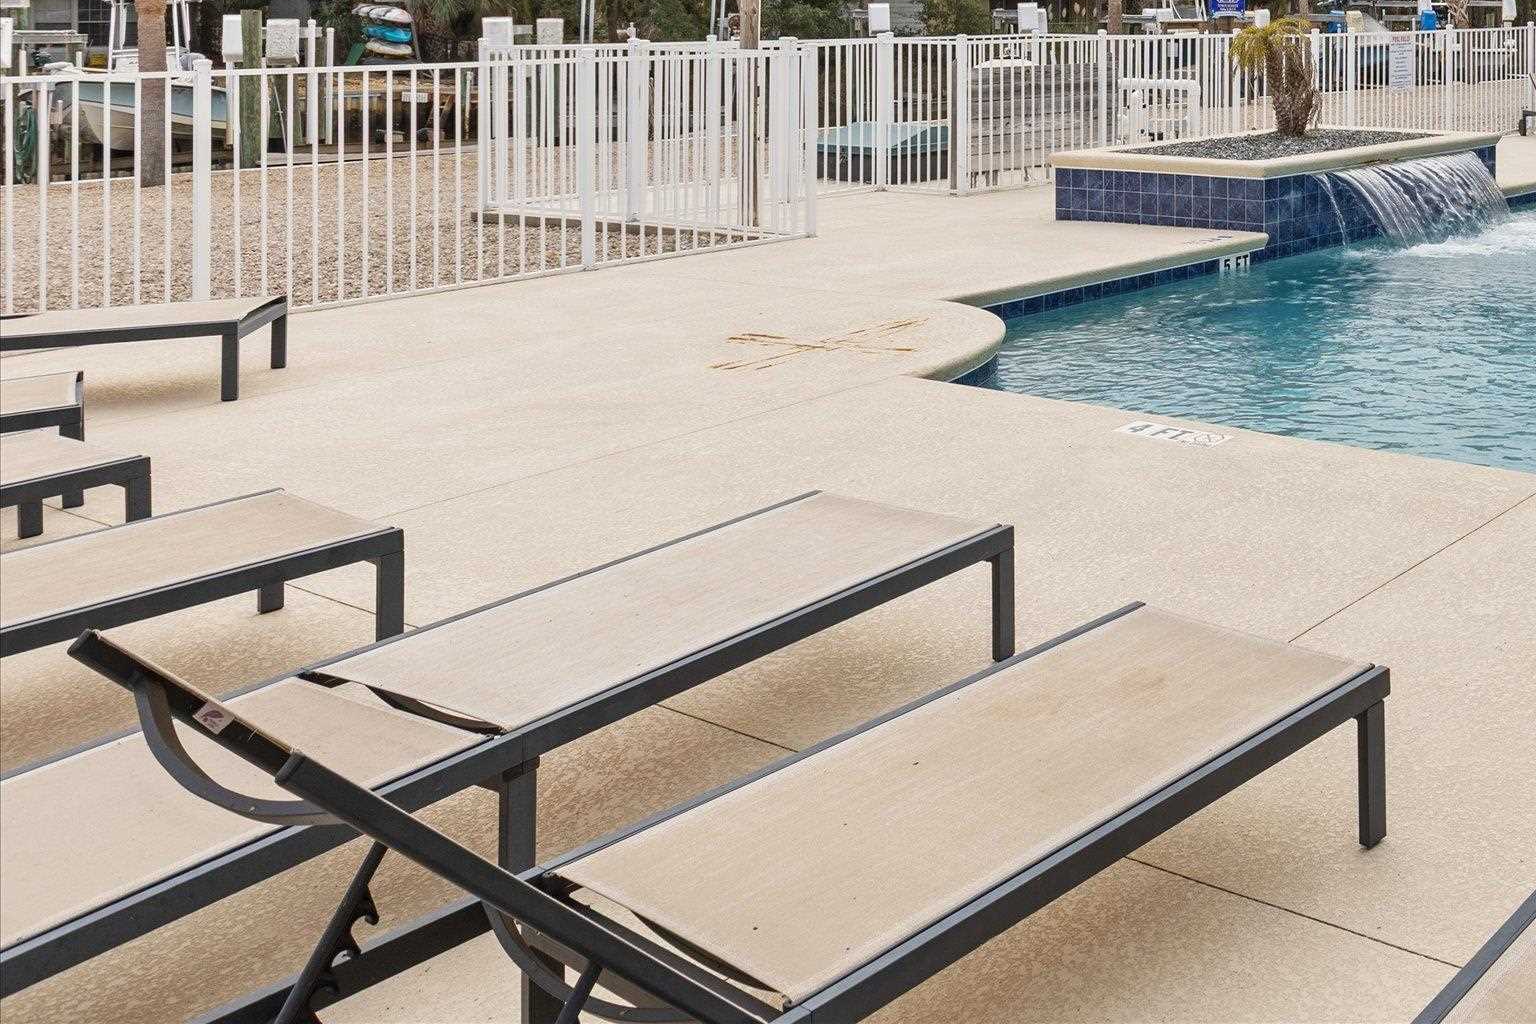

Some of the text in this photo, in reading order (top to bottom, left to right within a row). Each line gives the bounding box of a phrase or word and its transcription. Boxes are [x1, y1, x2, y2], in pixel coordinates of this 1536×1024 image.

[1223, 254, 1249, 270] 5 FT
[1128, 423, 1195, 440] 4 FT
